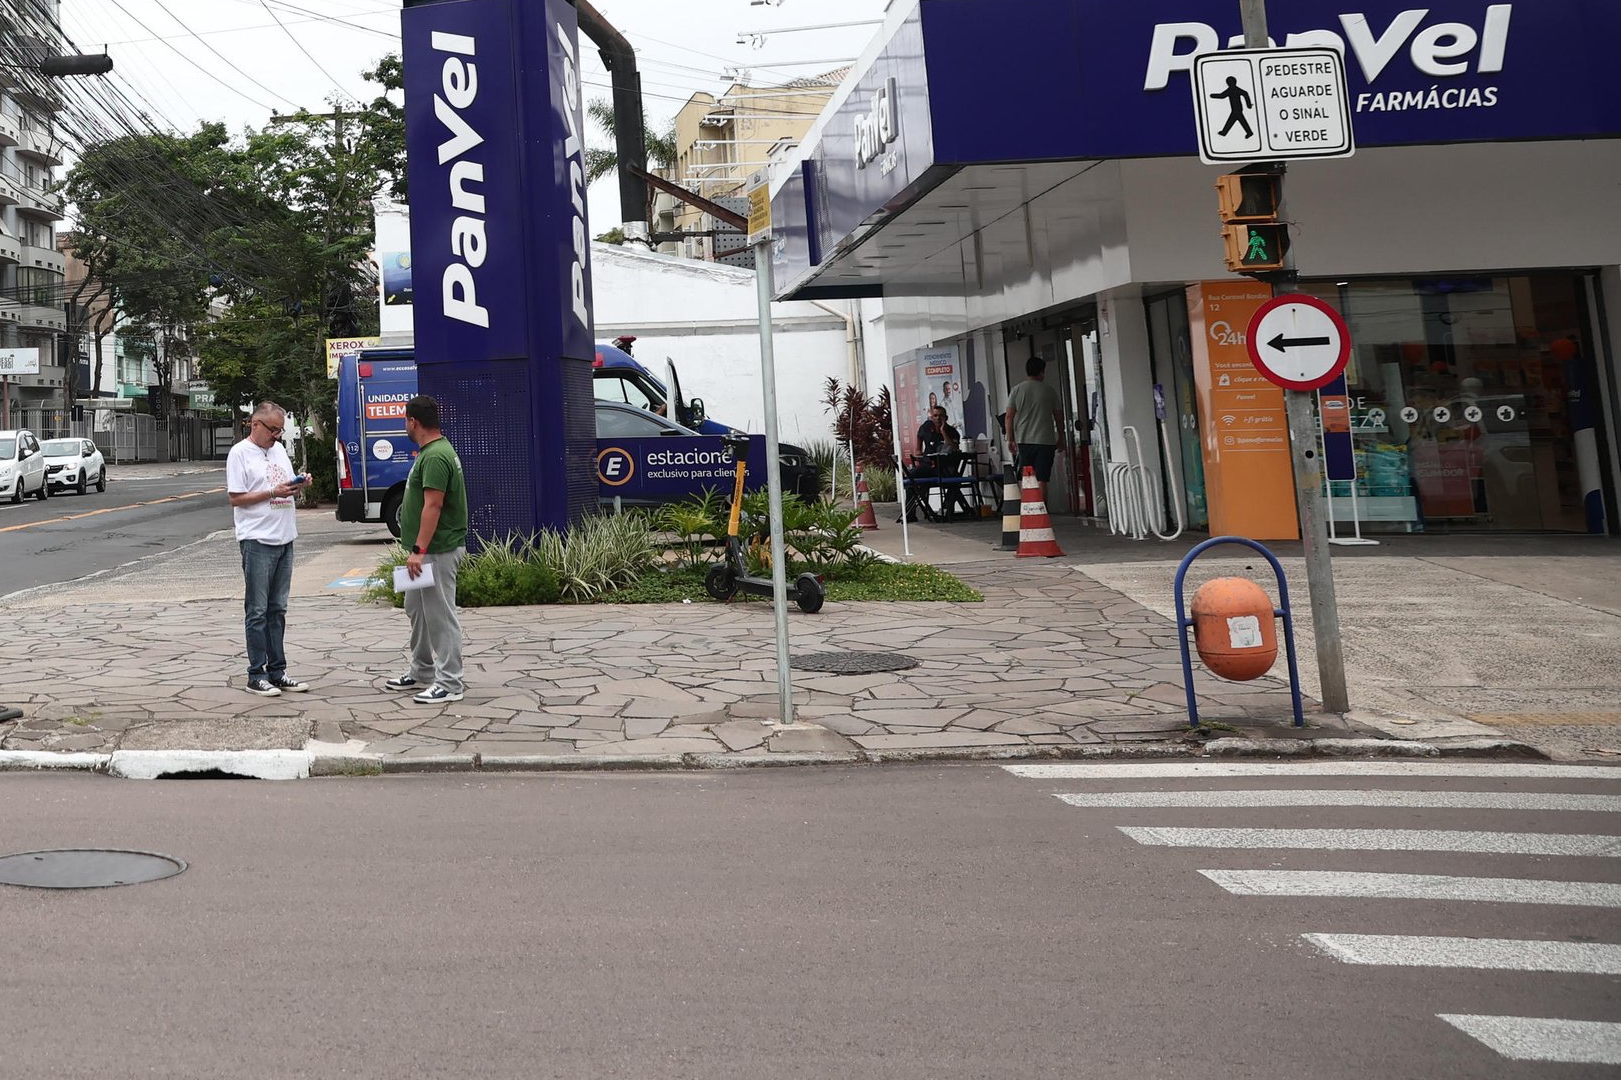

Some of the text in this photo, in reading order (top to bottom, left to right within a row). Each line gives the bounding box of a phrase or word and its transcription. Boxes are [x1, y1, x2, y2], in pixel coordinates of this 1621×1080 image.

[1265, 62, 1332, 77] PEDESTRE
[1271, 84, 1332, 98] AGUARDE
[1356, 85, 1498, 113] FARMÁCIAS
[1280, 106, 1329, 120] O SINAL
[1285, 129, 1328, 142] VERDE
[329, 341, 364, 350] XEROX
[368, 394, 409, 403] UNIDADE
[368, 405, 407, 416] TELEM
[647, 448, 732, 465] estacione
[647, 469, 689, 479] exclusivo
[691, 469, 712, 479] para
